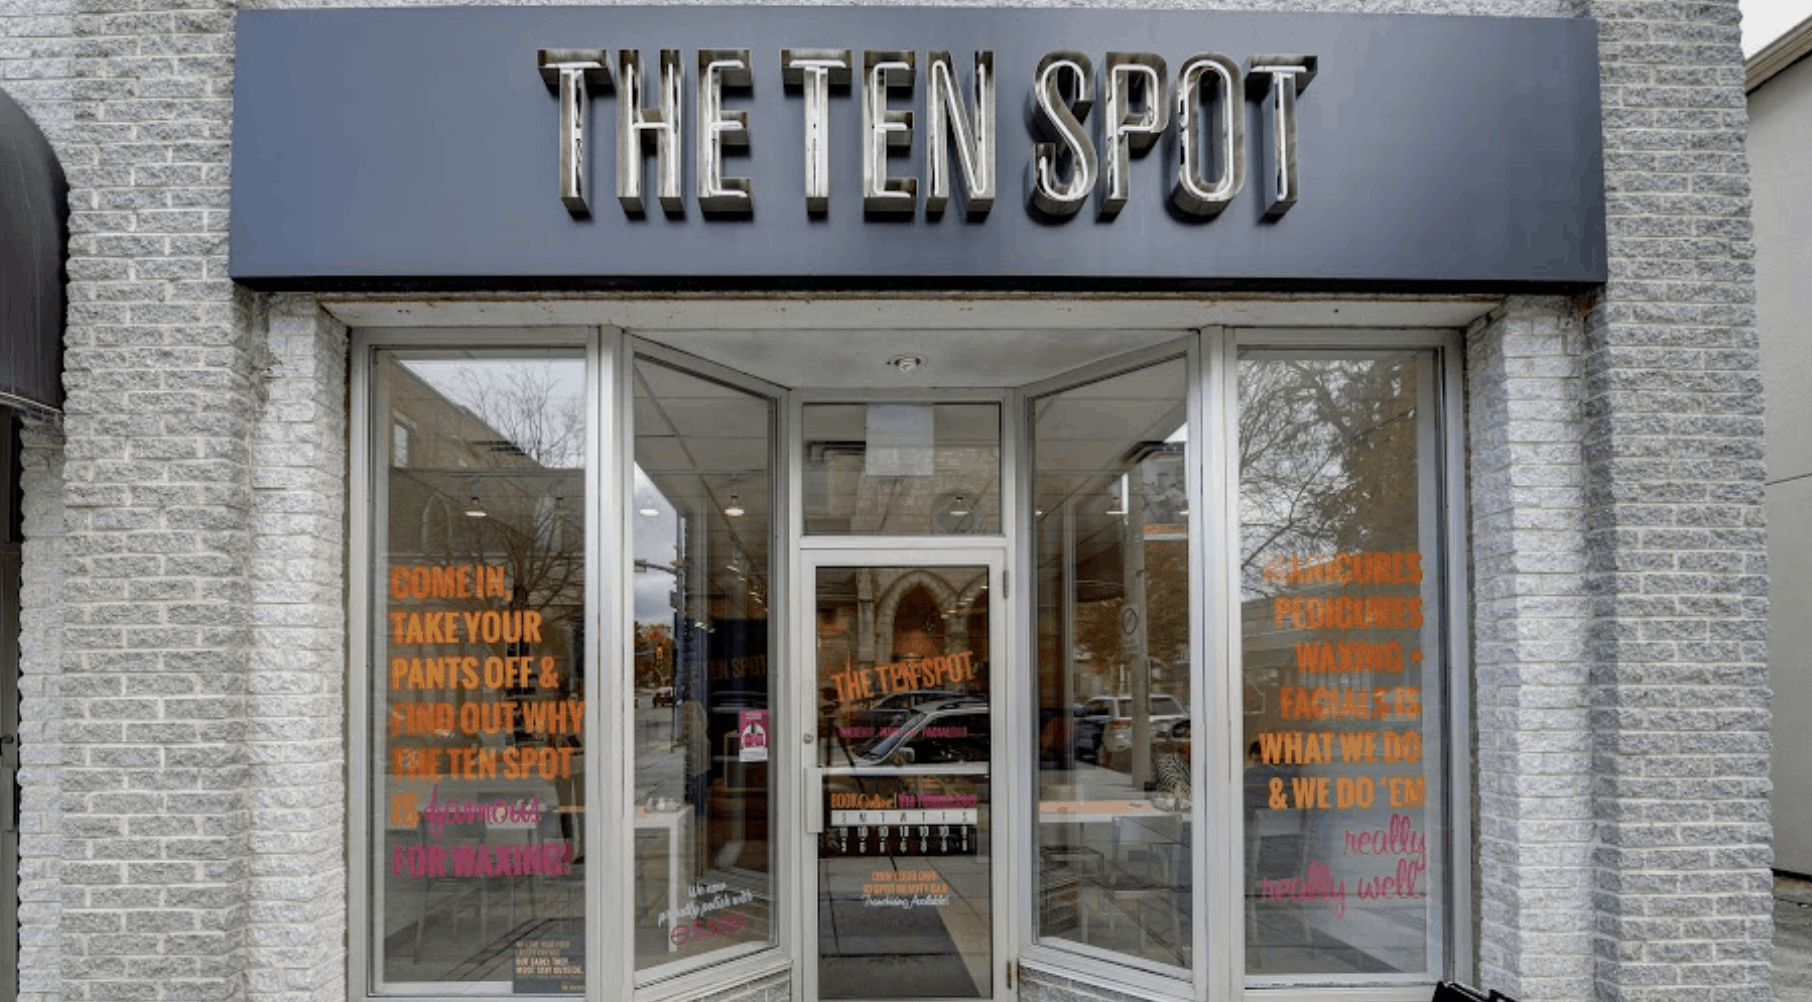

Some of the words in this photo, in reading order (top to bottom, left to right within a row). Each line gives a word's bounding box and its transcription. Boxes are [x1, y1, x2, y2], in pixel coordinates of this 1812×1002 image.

[537, 48, 754, 220] THE
[781, 48, 995, 220] TEN
[1034, 49, 1317, 224] SPOT
[389, 565, 470, 600] COME
[476, 565, 513, 601] IN,
[388, 610, 459, 643] TAKE
[464, 610, 542, 643] YOUR
[1274, 596, 1423, 629] PEDICURES
[391, 656, 479, 690] PANTS
[484, 656, 532, 689] OFF
[539, 656, 559, 689] &
[1295, 641, 1403, 674] WAXING
[830, 667, 875, 701] THE
[874, 662, 918, 694] TEN
[921, 650, 974, 688] SPOT
[391, 701, 455, 735] FIND
[460, 701, 517, 734] OUT
[523, 701, 585, 734] WHY
[1279, 685, 1390, 720] FACIALS
[1394, 685, 1421, 720] IS
[391, 747, 442, 780] THE
[447, 747, 498, 780] TEN
[502, 747, 574, 780] SPOT
[1259, 731, 1334, 764] WHAT
[1339, 732, 1377, 764] WE
[1382, 731, 1422, 764] DO
[390, 792, 419, 827] IS
[1268, 777, 1287, 809] &
[1292, 777, 1331, 809] WE
[1337, 777, 1374, 808] DO
[1346, 814, 1426, 872] really
[392, 844, 446, 878] FOR
[1261, 860, 1346, 920] really
